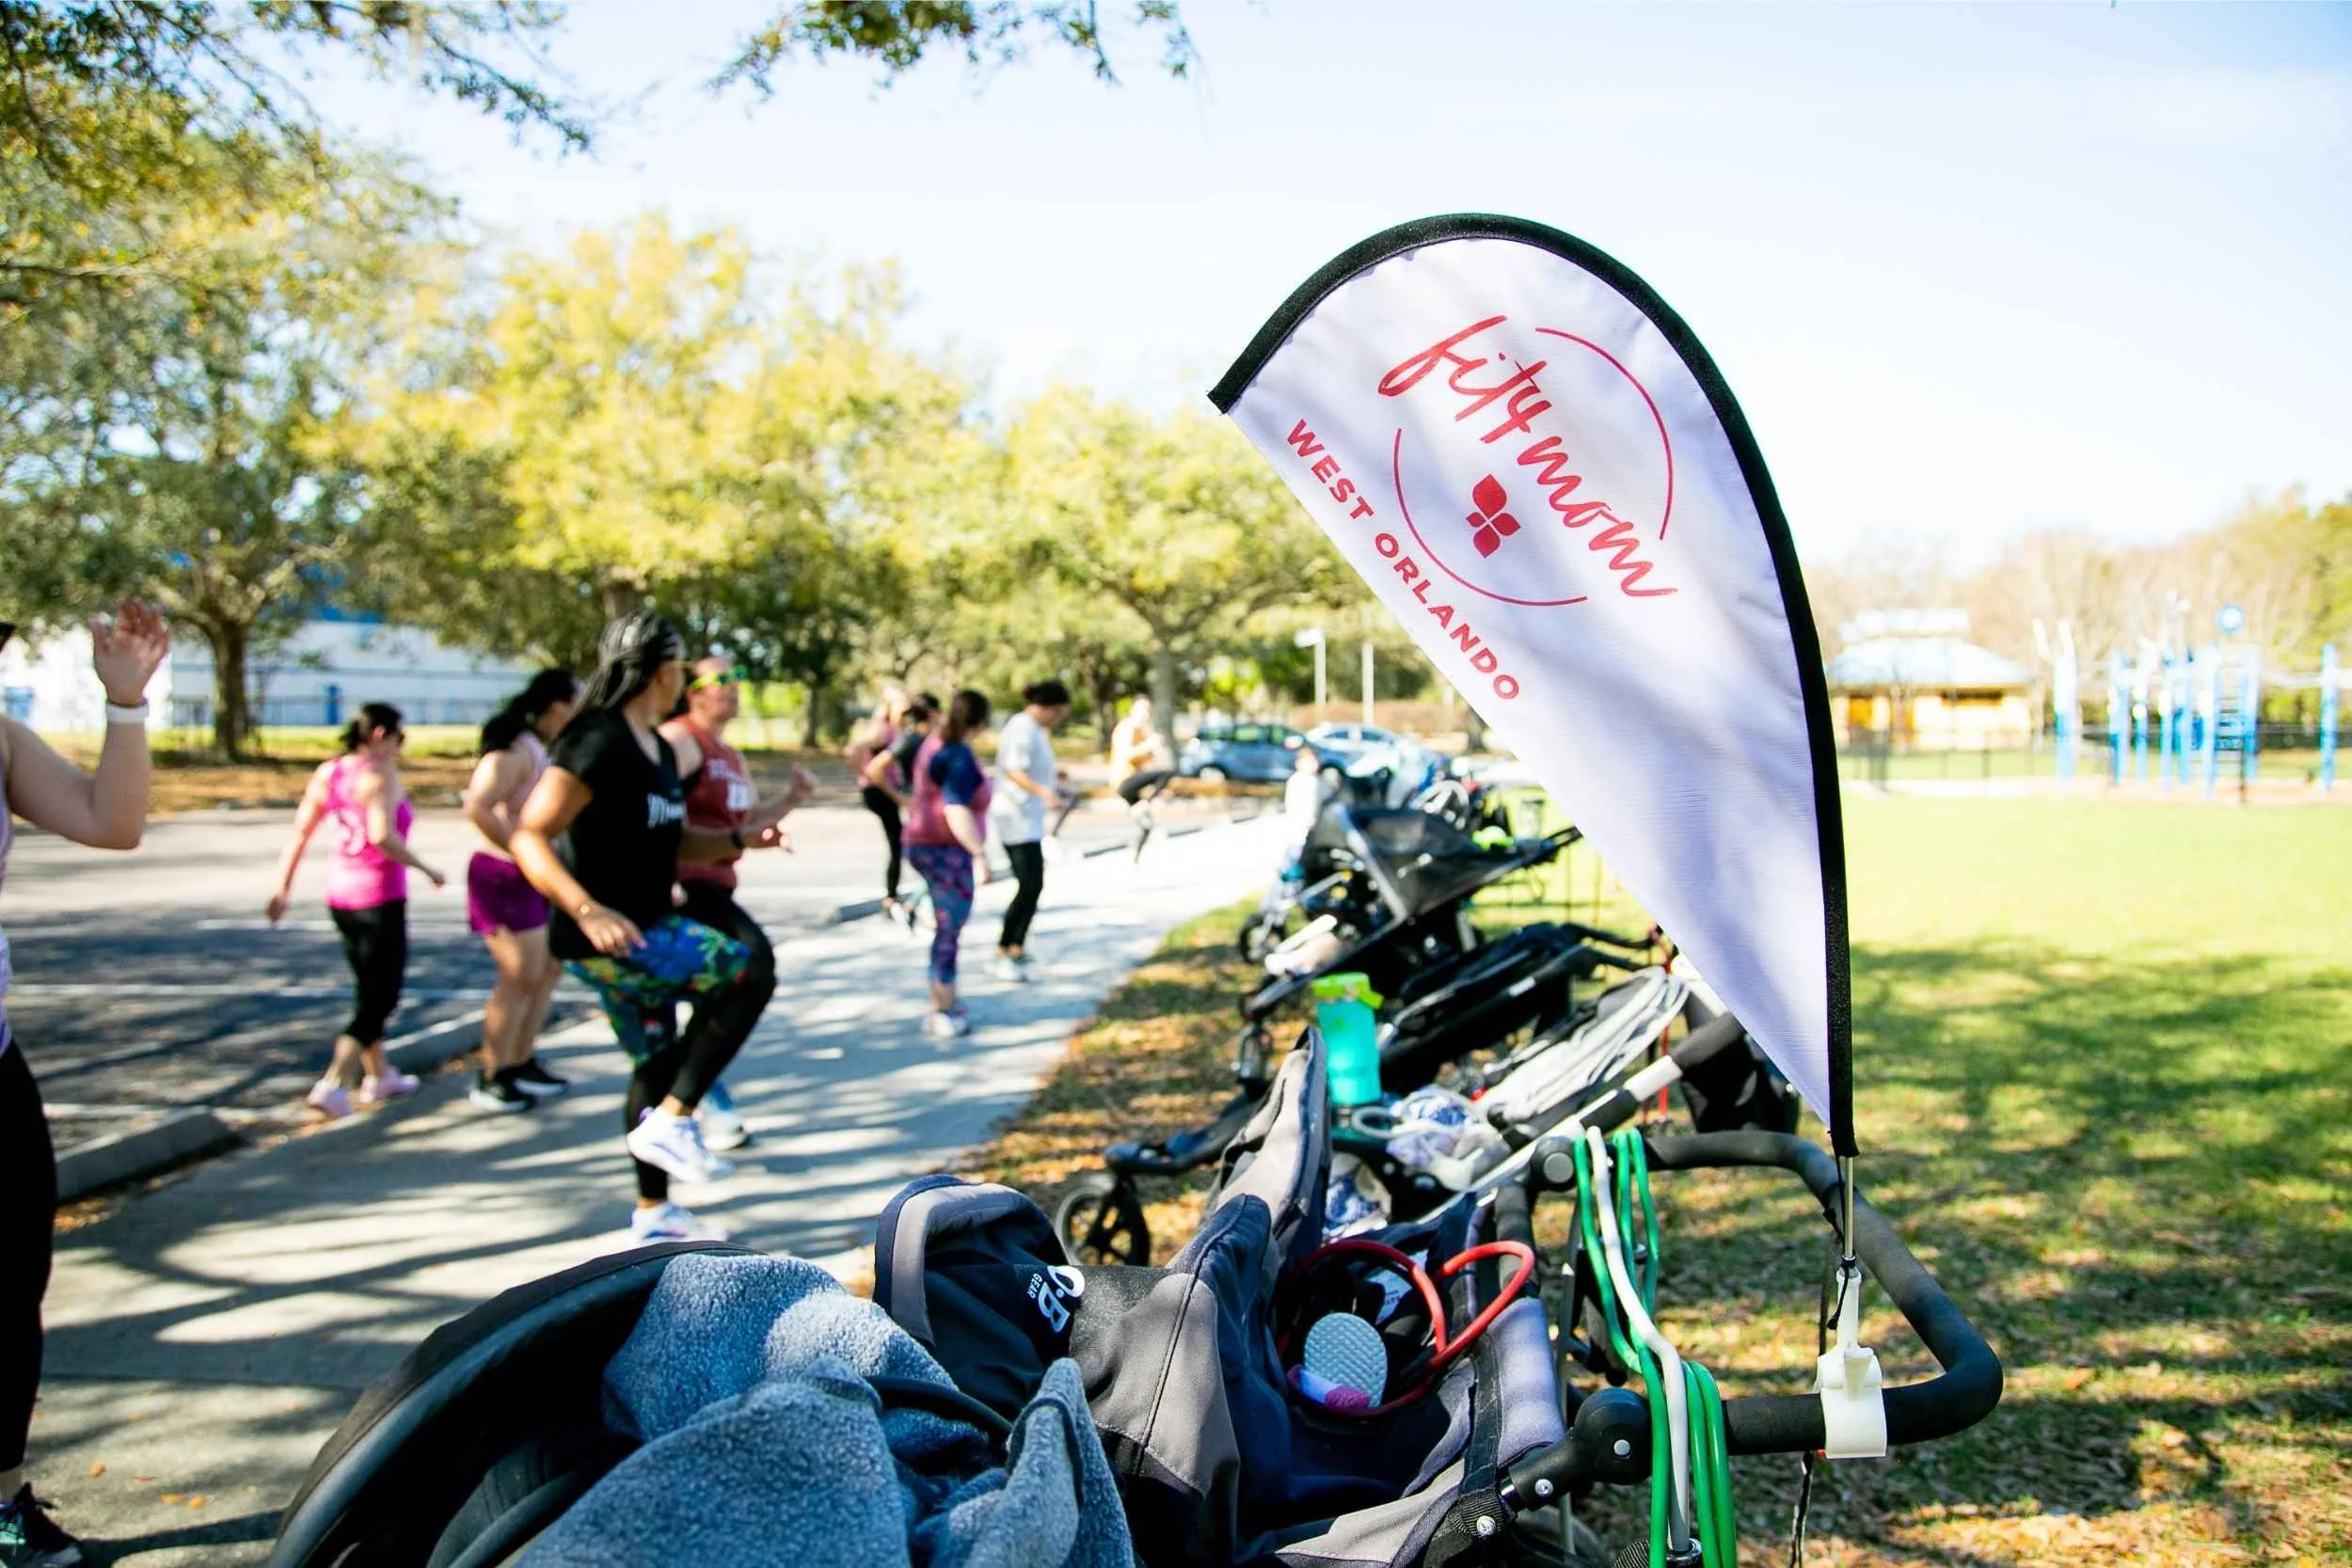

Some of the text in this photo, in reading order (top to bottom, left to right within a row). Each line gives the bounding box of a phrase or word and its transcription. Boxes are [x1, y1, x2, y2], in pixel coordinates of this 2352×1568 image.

[1287, 419, 1519, 699] WEST ORLANDO
[1026, 1273, 1043, 1299] GEAR
